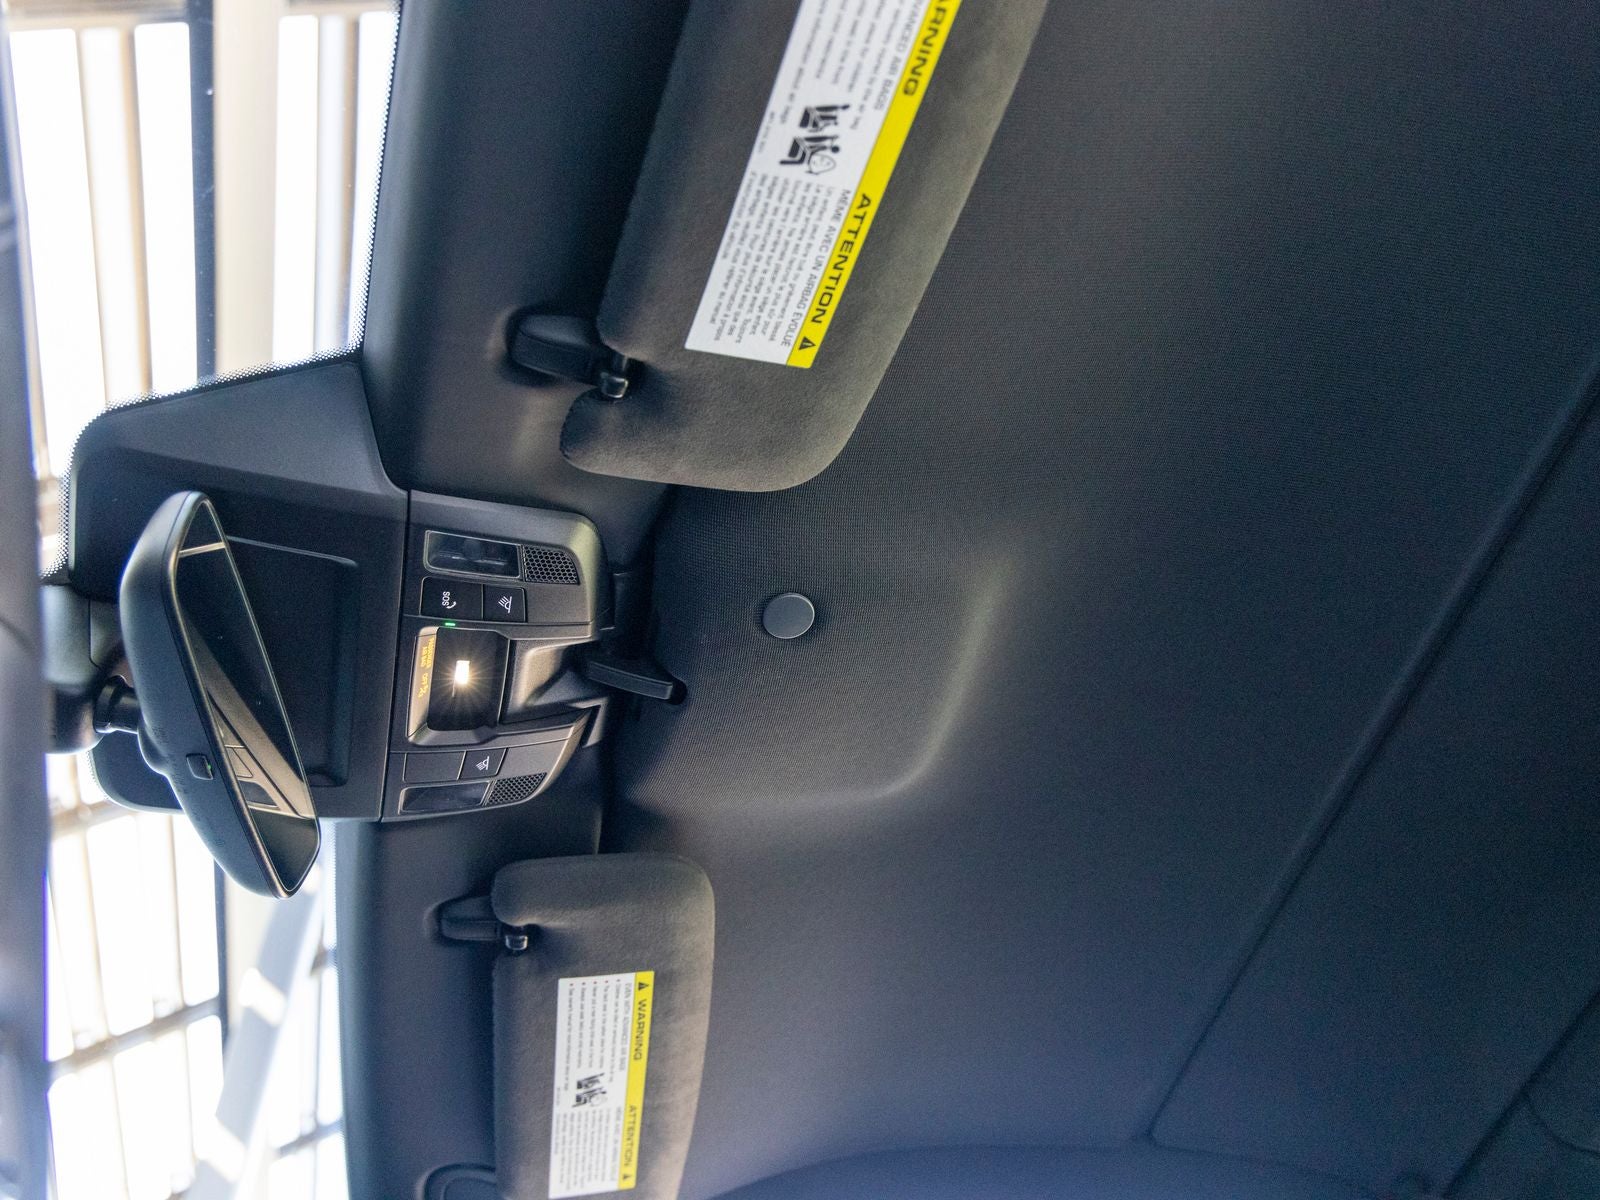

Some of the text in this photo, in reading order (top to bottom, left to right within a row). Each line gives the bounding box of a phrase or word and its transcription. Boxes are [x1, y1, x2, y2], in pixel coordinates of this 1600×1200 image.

[903, 0, 949, 96] RNING
[810, 193, 873, 323] ATTENTION
[812, 255, 824, 270] UN
[819, 226, 837, 252] AVEC
[796, 273, 817, 309] AIRBAG
[442, 591, 451, 607] SOS
[633, 998, 647, 1060] WARNING
[623, 1104, 637, 1166] ATTENTION
